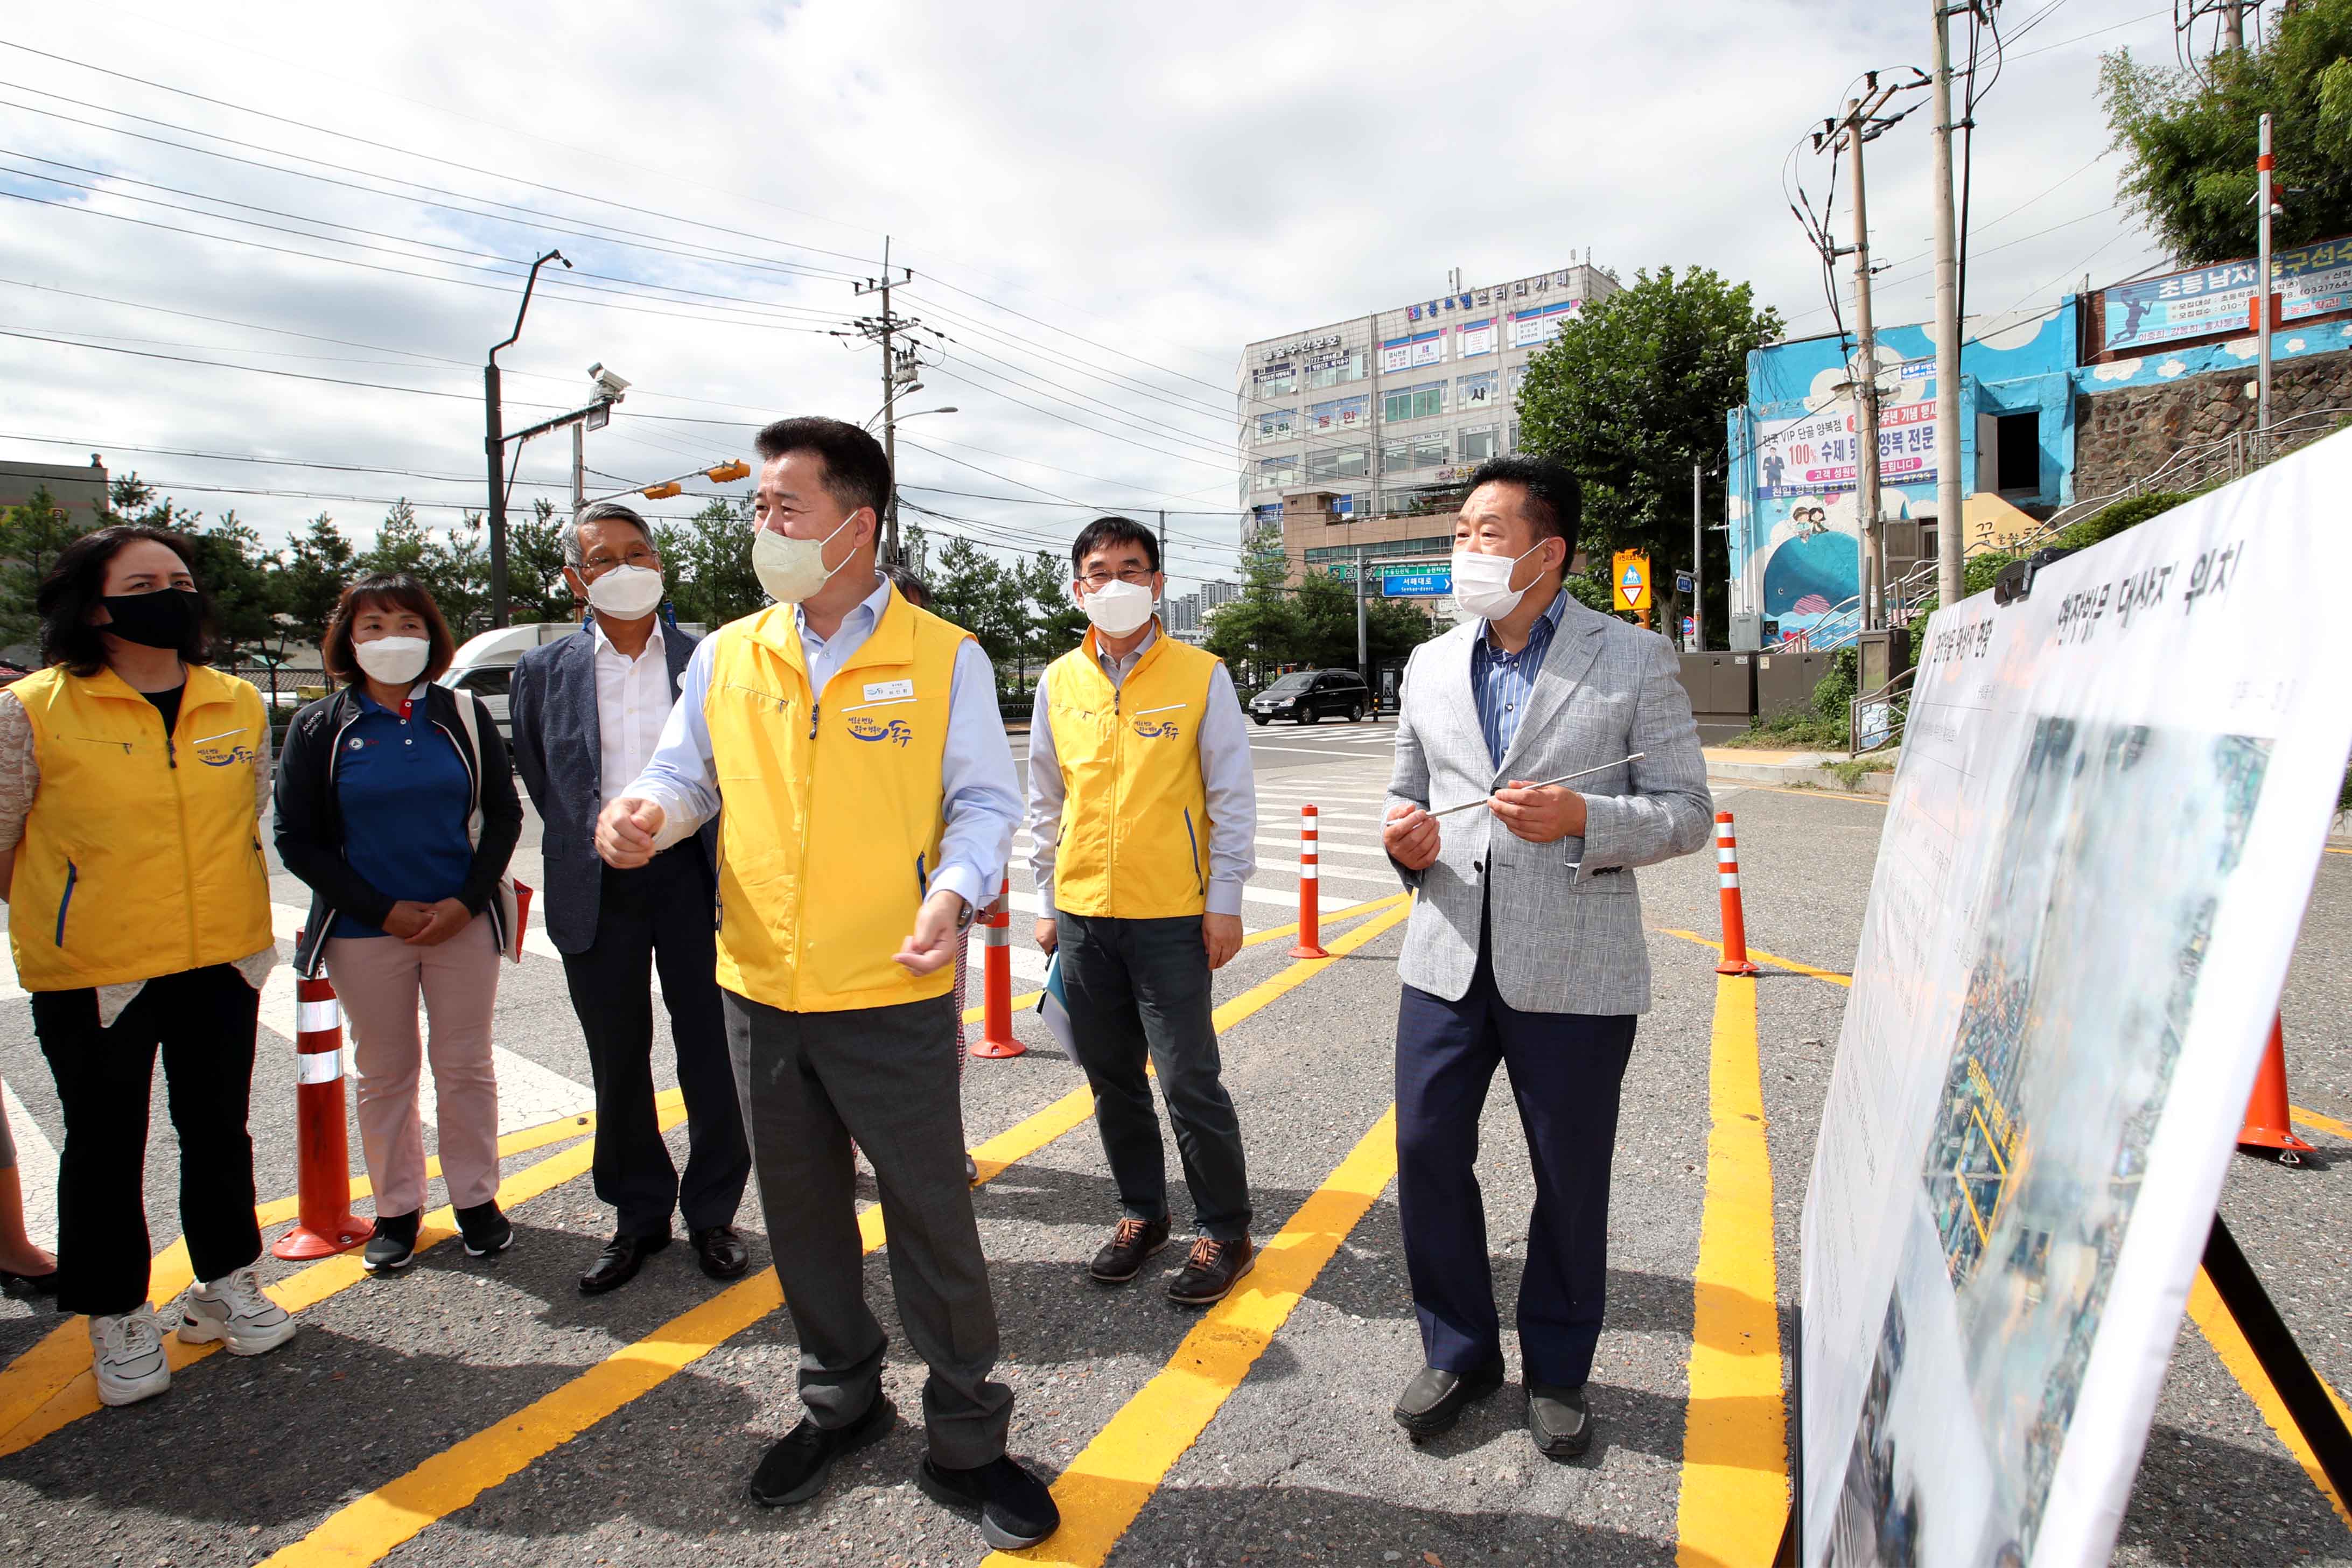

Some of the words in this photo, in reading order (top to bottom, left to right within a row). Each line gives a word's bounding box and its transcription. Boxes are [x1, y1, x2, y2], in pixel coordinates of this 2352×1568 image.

[2159, 274, 2203, 299] 초등
[2208, 263, 2256, 289] 남자
[2180, 298, 2210, 309] 모집대상
[2291, 302, 2311, 315] 농구
[2315, 297, 2340, 309] 학교!
[1471, 387, 1486, 401] 사
[1780, 430, 1795, 443] VIP
[1798, 426, 1814, 440] 단골
[1817, 419, 1842, 436] 양복점
[1901, 406, 1918, 422] 기념
[1788, 444, 1818, 466] 100%
[1822, 439, 1844, 463] 수제
[1908, 426, 1934, 452] 전문
[1814, 468, 1830, 480] 고객
[1403, 577, 1431, 585] 서해대로
[2184, 540, 2244, 615] 위치
[888, 720, 913, 747] 동구
[1162, 722, 1179, 741] 동구
[233, 746, 255, 765] 동구
